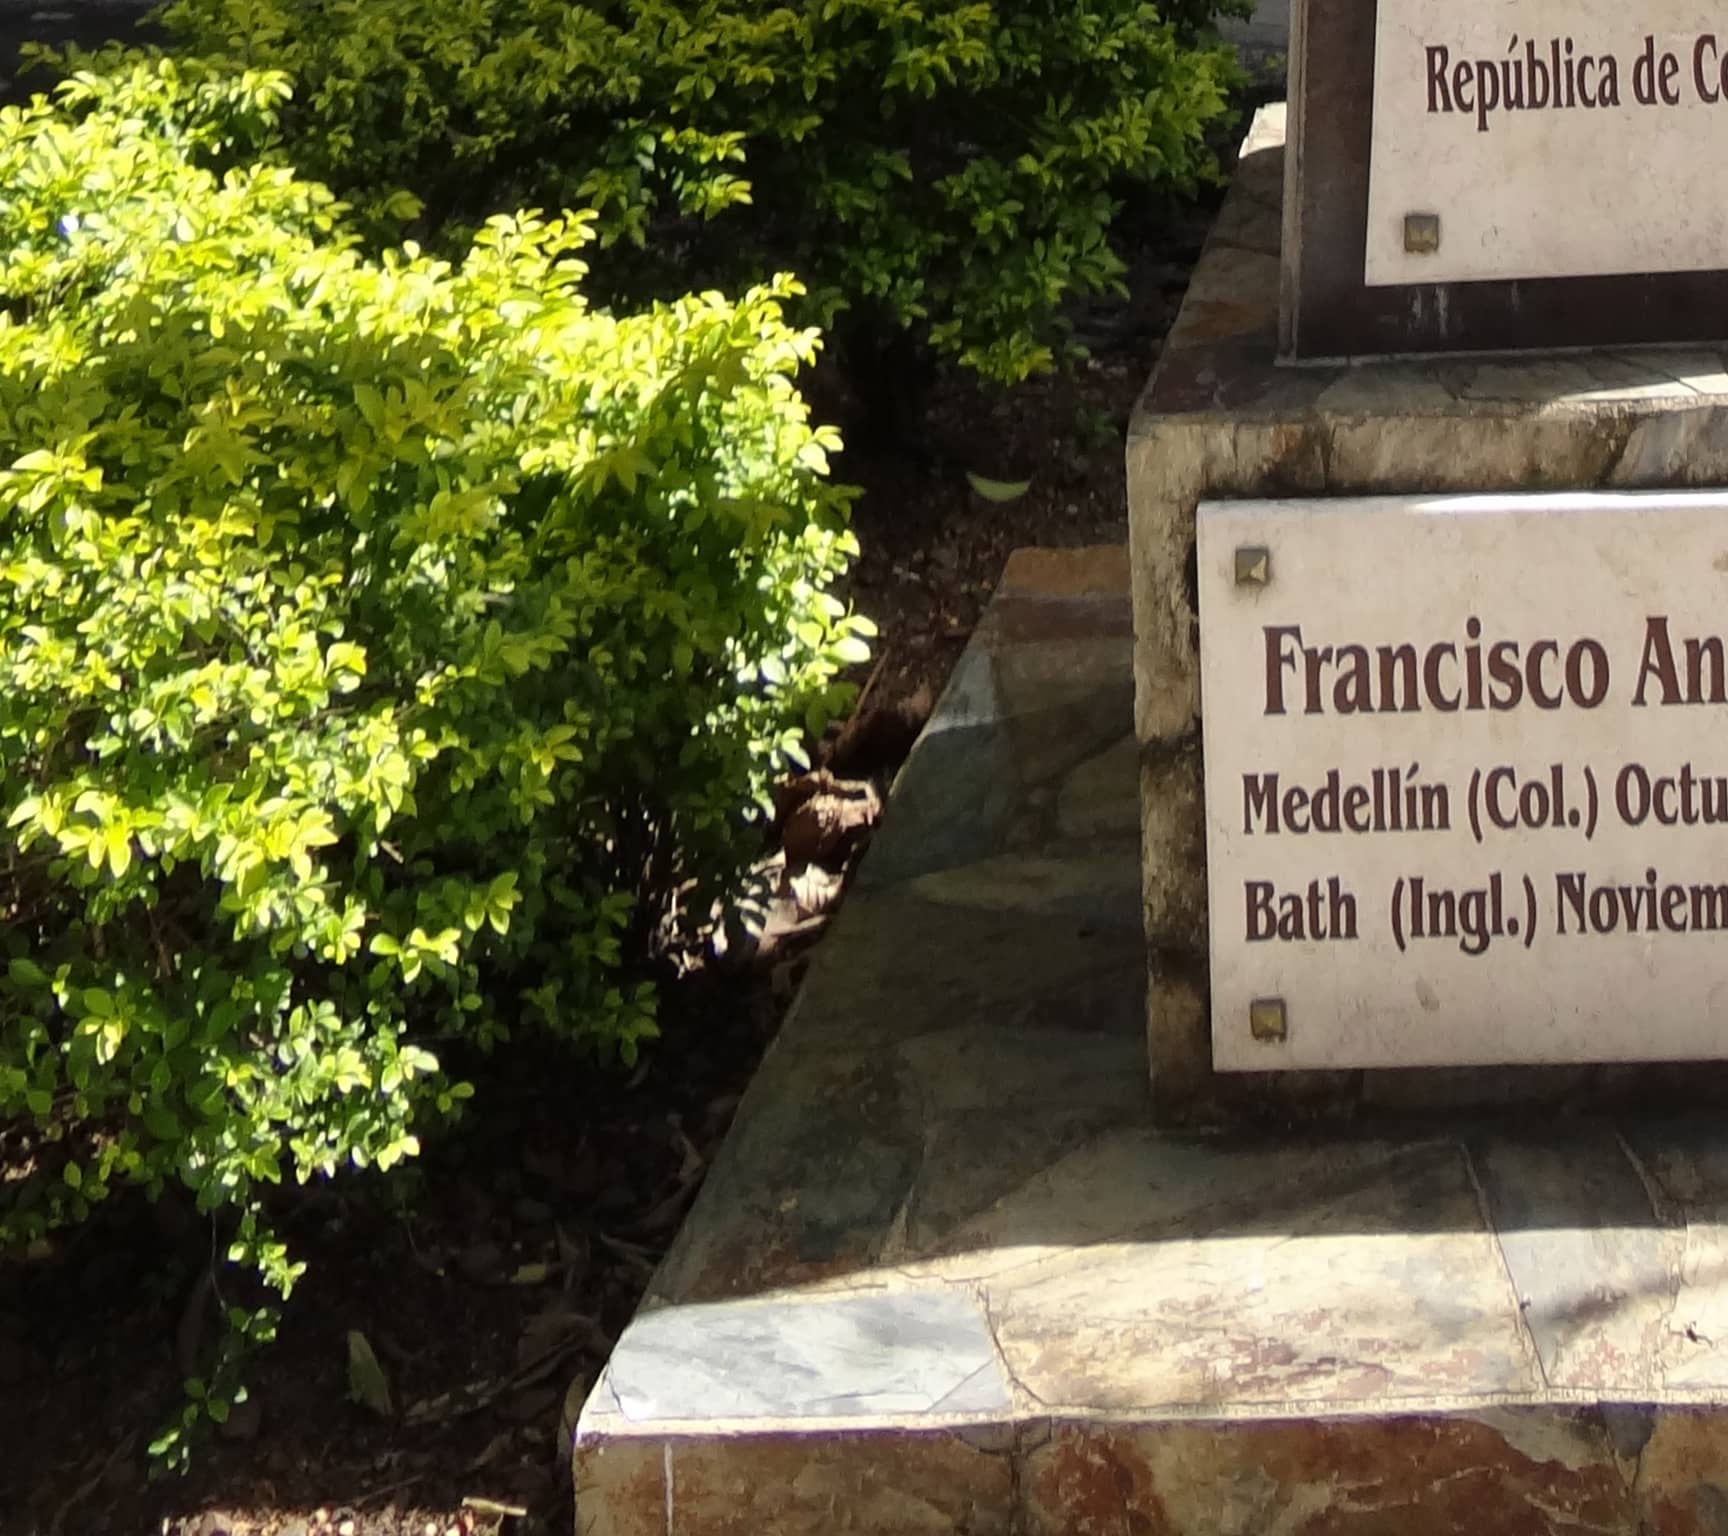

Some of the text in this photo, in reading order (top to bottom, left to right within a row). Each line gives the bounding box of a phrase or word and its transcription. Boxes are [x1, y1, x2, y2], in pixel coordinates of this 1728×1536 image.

[1425, 34, 1621, 132] República
[1632, 35, 1680, 106] de
[1263, 616, 1610, 715] Francisco
[1242, 762, 1451, 835] Medellín
[1467, 763, 1599, 844] (Col.)
[1244, 876, 1359, 942] Bath
[1391, 871, 1537, 957] (Ingl.)
